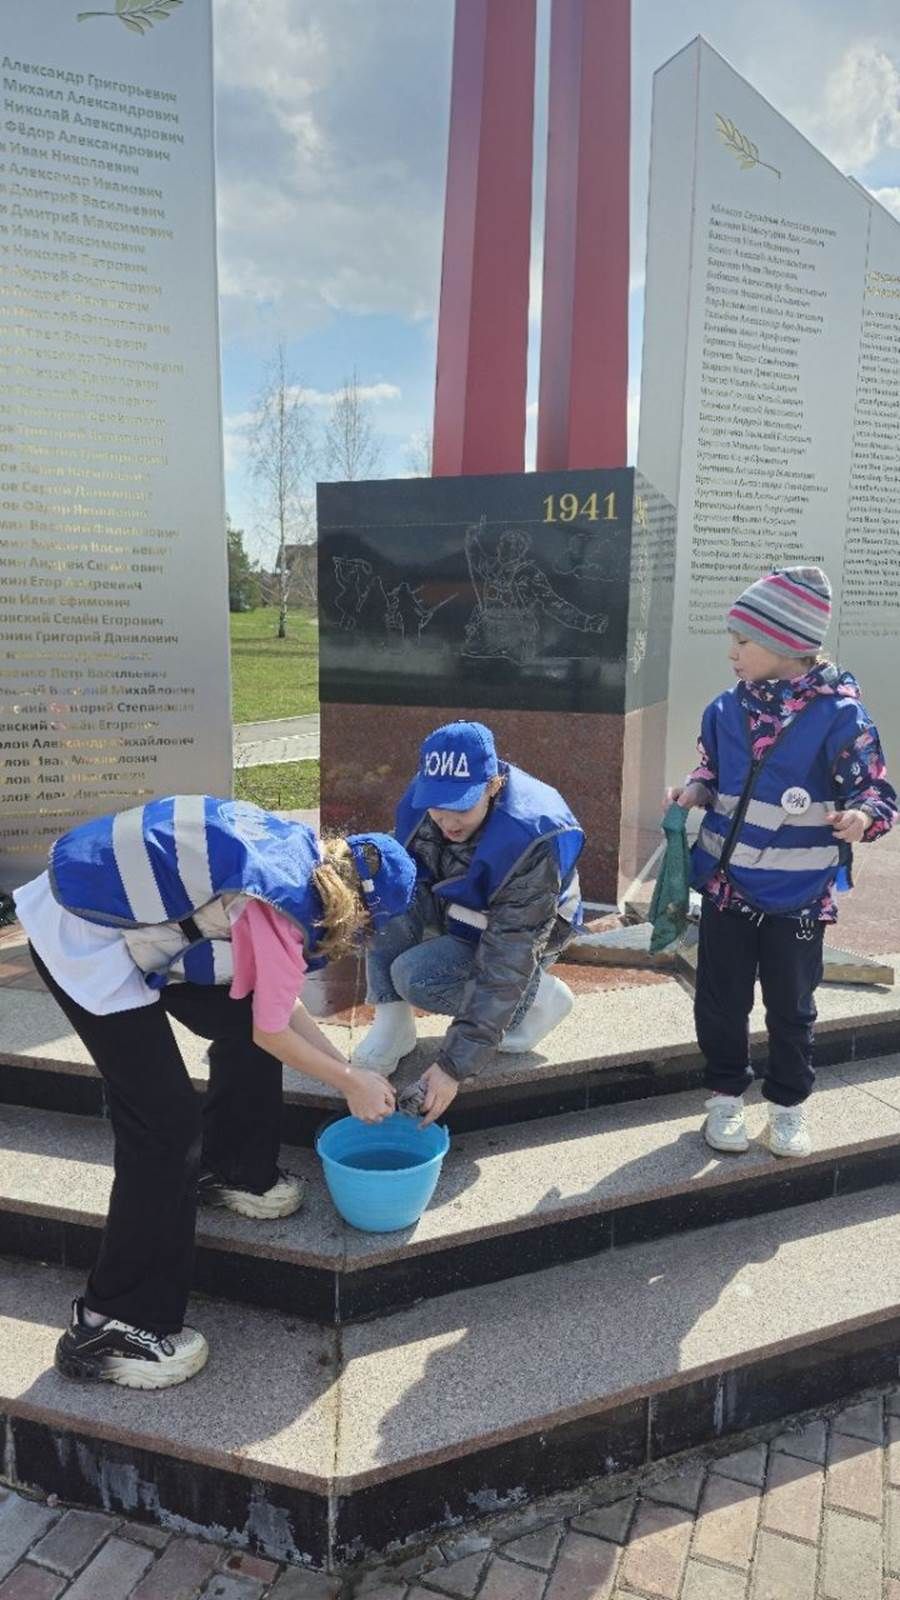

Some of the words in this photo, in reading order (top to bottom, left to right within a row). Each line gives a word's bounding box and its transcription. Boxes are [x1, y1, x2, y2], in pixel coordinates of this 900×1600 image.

[2, 56, 84, 87] Александр
[88, 73, 177, 103] Григорьевич
[3, 77, 63, 101] Михаил
[66, 90, 179, 123] Александрович
[3, 98, 70, 122] Николай
[73, 111, 185, 145] Александрович
[58, 129, 171, 162] Александрович
[542, 491, 619, 523] 1941
[36, 628, 100, 647] Григорий
[103, 631, 179, 646] Данилович
[424, 750, 471, 778] ЮИД
